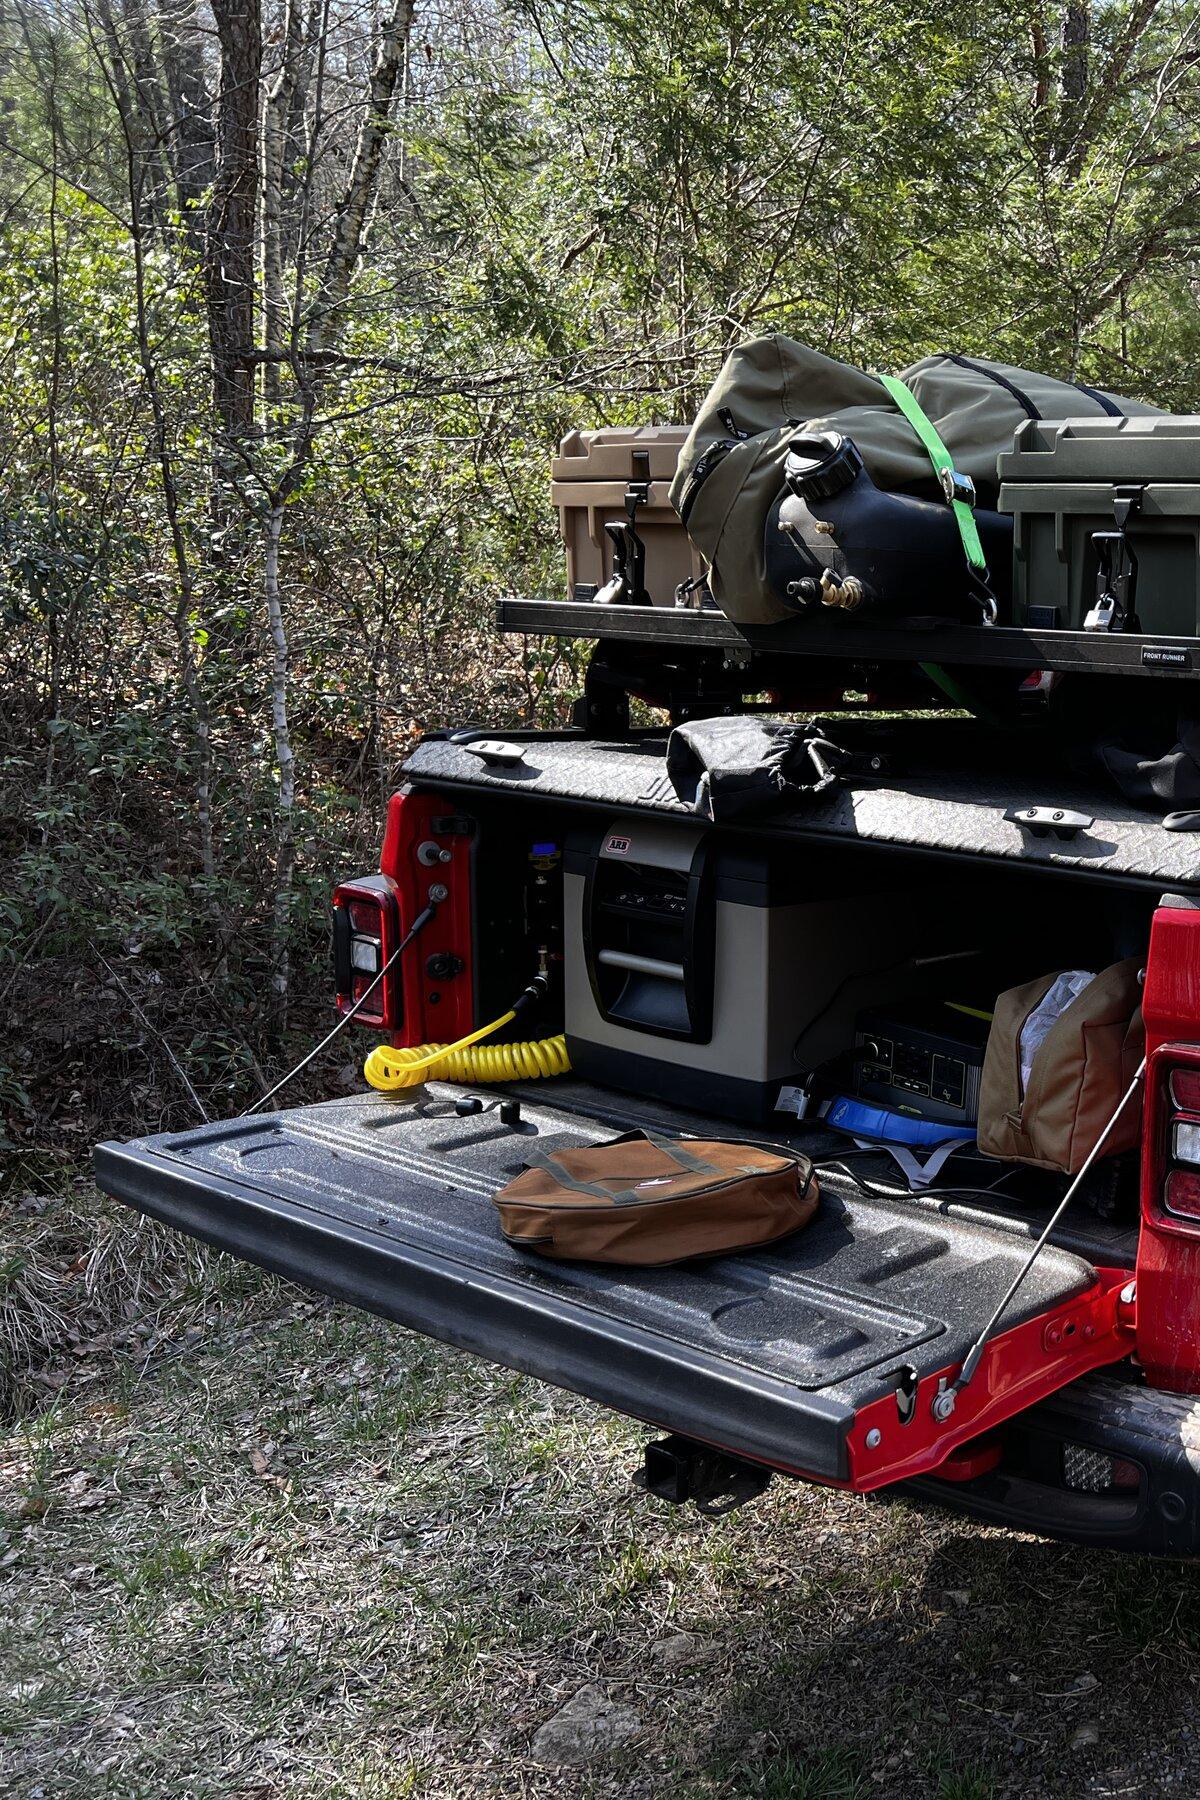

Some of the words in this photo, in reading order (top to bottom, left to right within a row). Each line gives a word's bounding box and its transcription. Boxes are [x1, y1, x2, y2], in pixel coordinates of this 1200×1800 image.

[1143, 652, 1161, 660] FRONT
[1162, 653, 1186, 661] RUNNER
[609, 839, 628, 850] ARB
